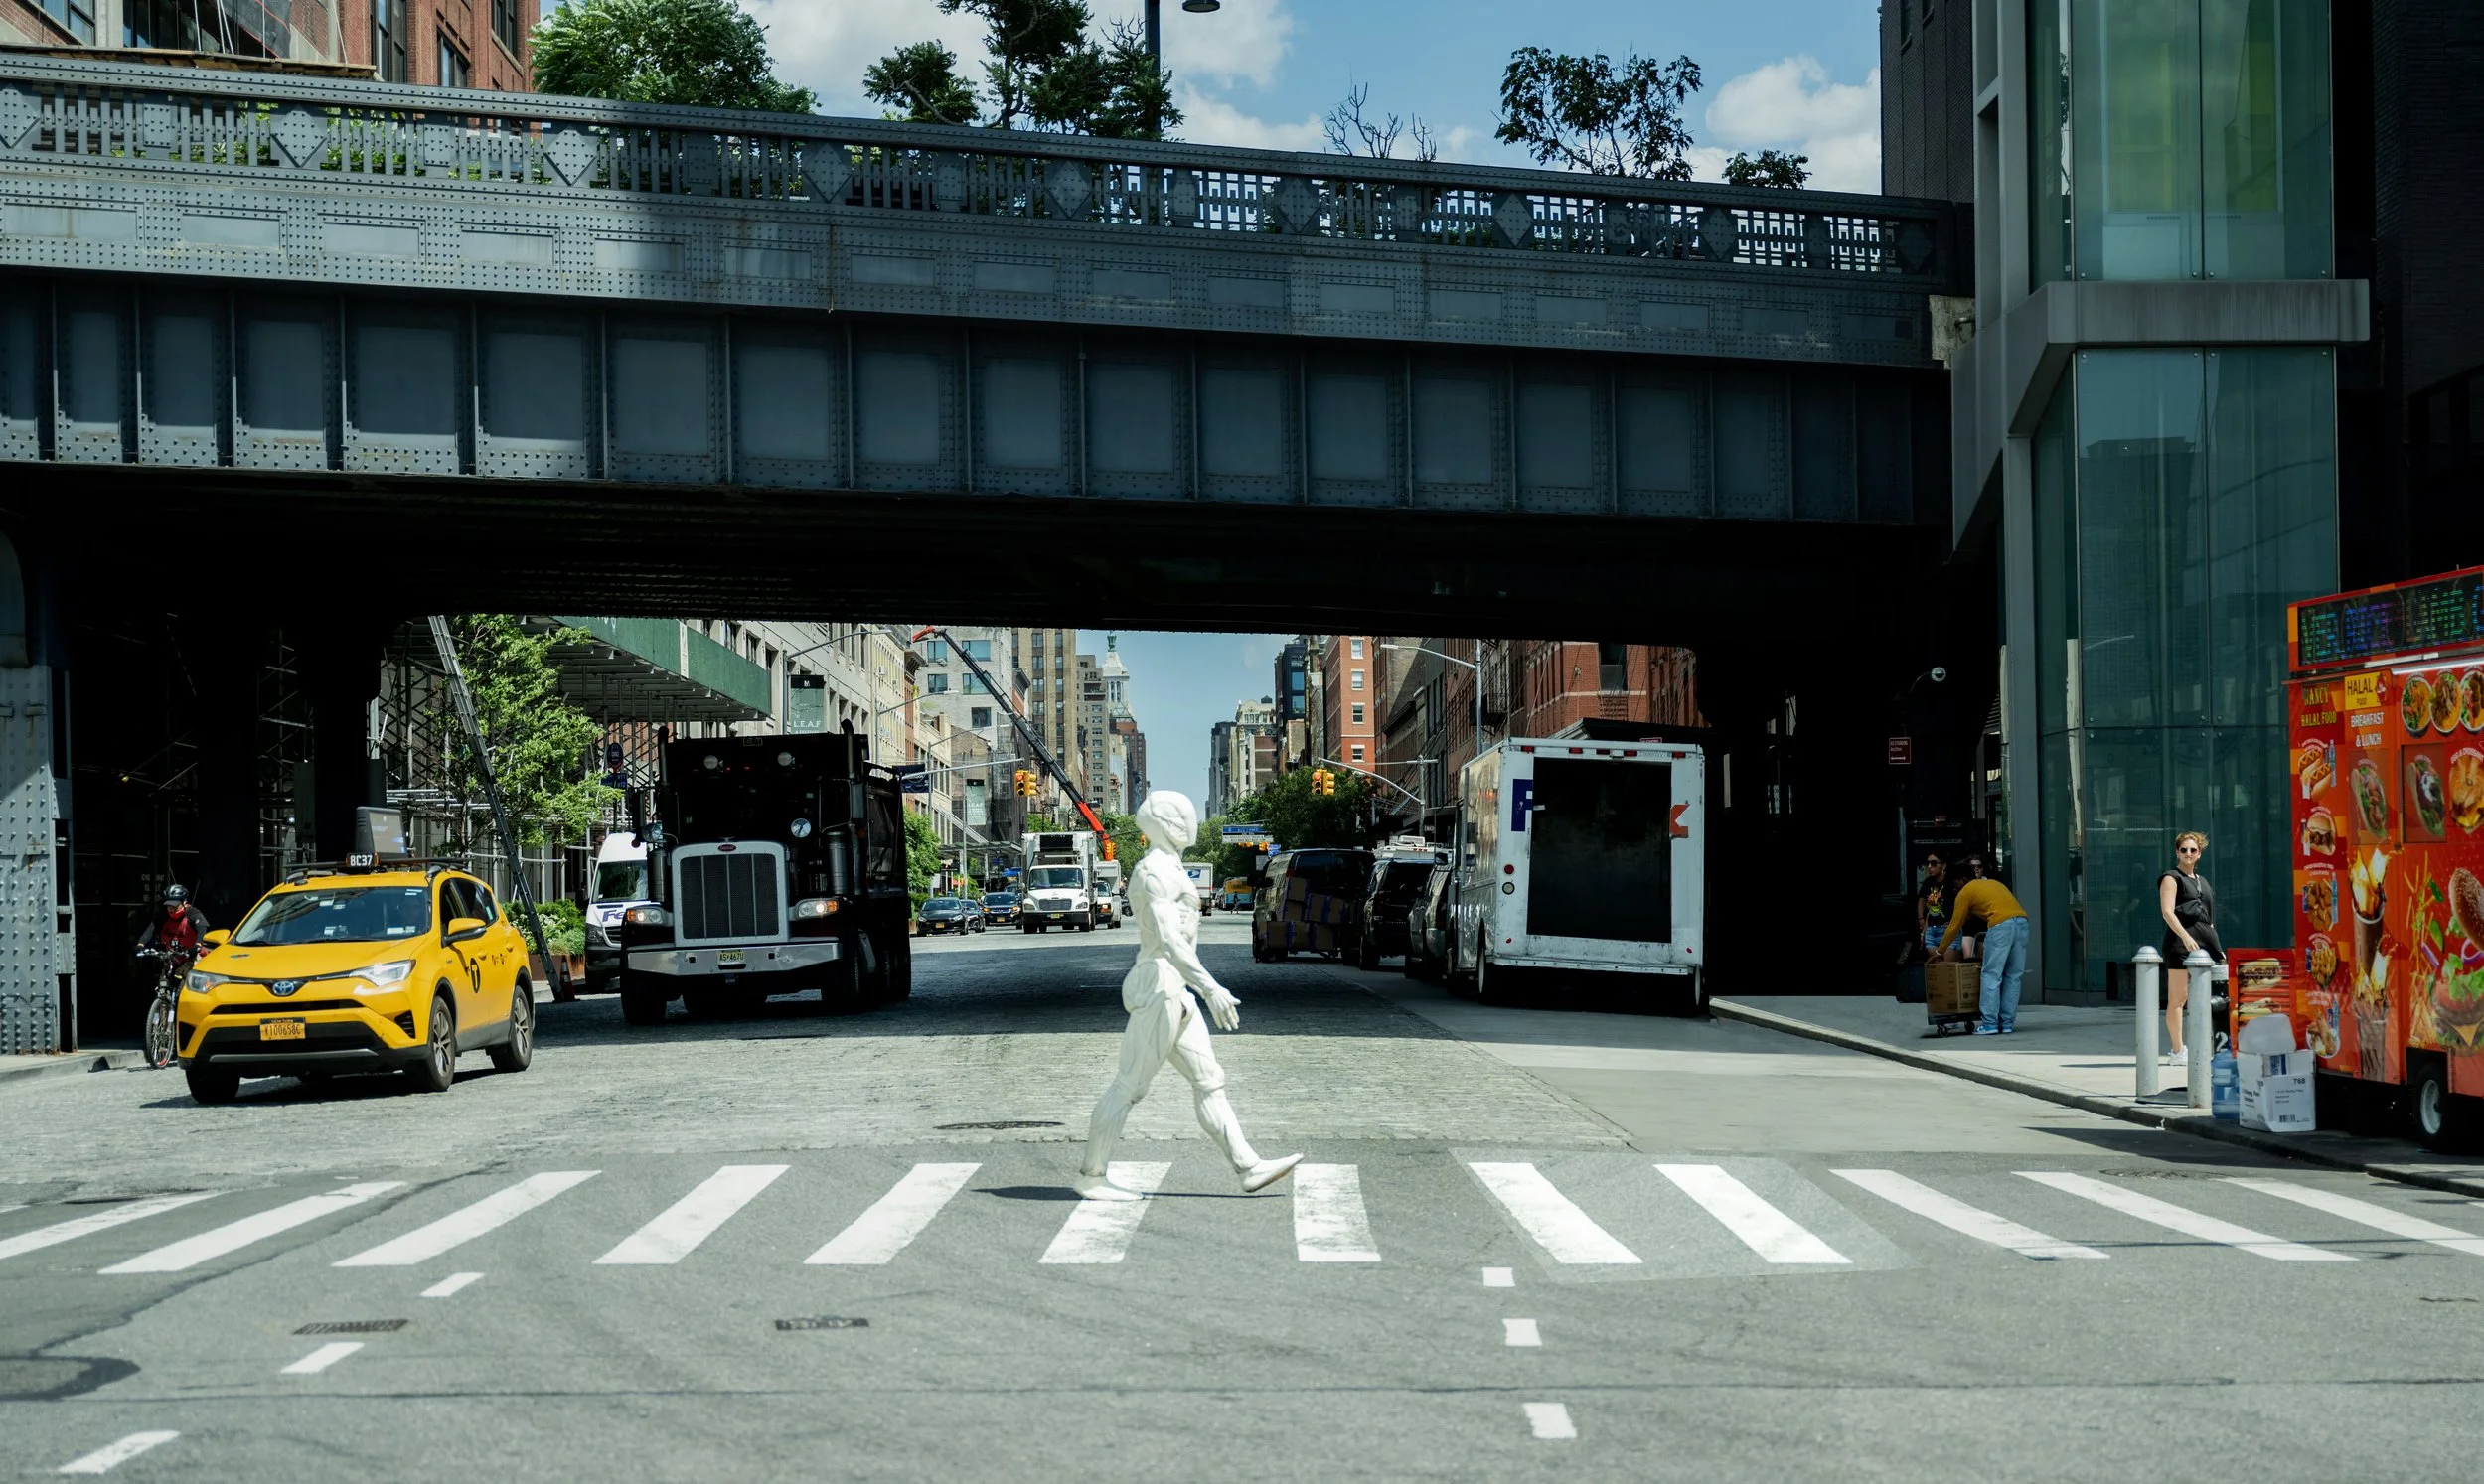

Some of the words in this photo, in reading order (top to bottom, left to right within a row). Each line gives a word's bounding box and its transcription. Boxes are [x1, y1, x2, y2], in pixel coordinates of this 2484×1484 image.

[2347, 677, 2374, 696] HALAL
[2300, 713, 2321, 727] HALAL
[2321, 711, 2337, 725] FOOD
[2350, 711, 2385, 728] BREAKFAST
[2355, 734, 2362, 747] &
[2361, 733, 2382, 747] LUNCH
[350, 854, 373, 867] 8C37
